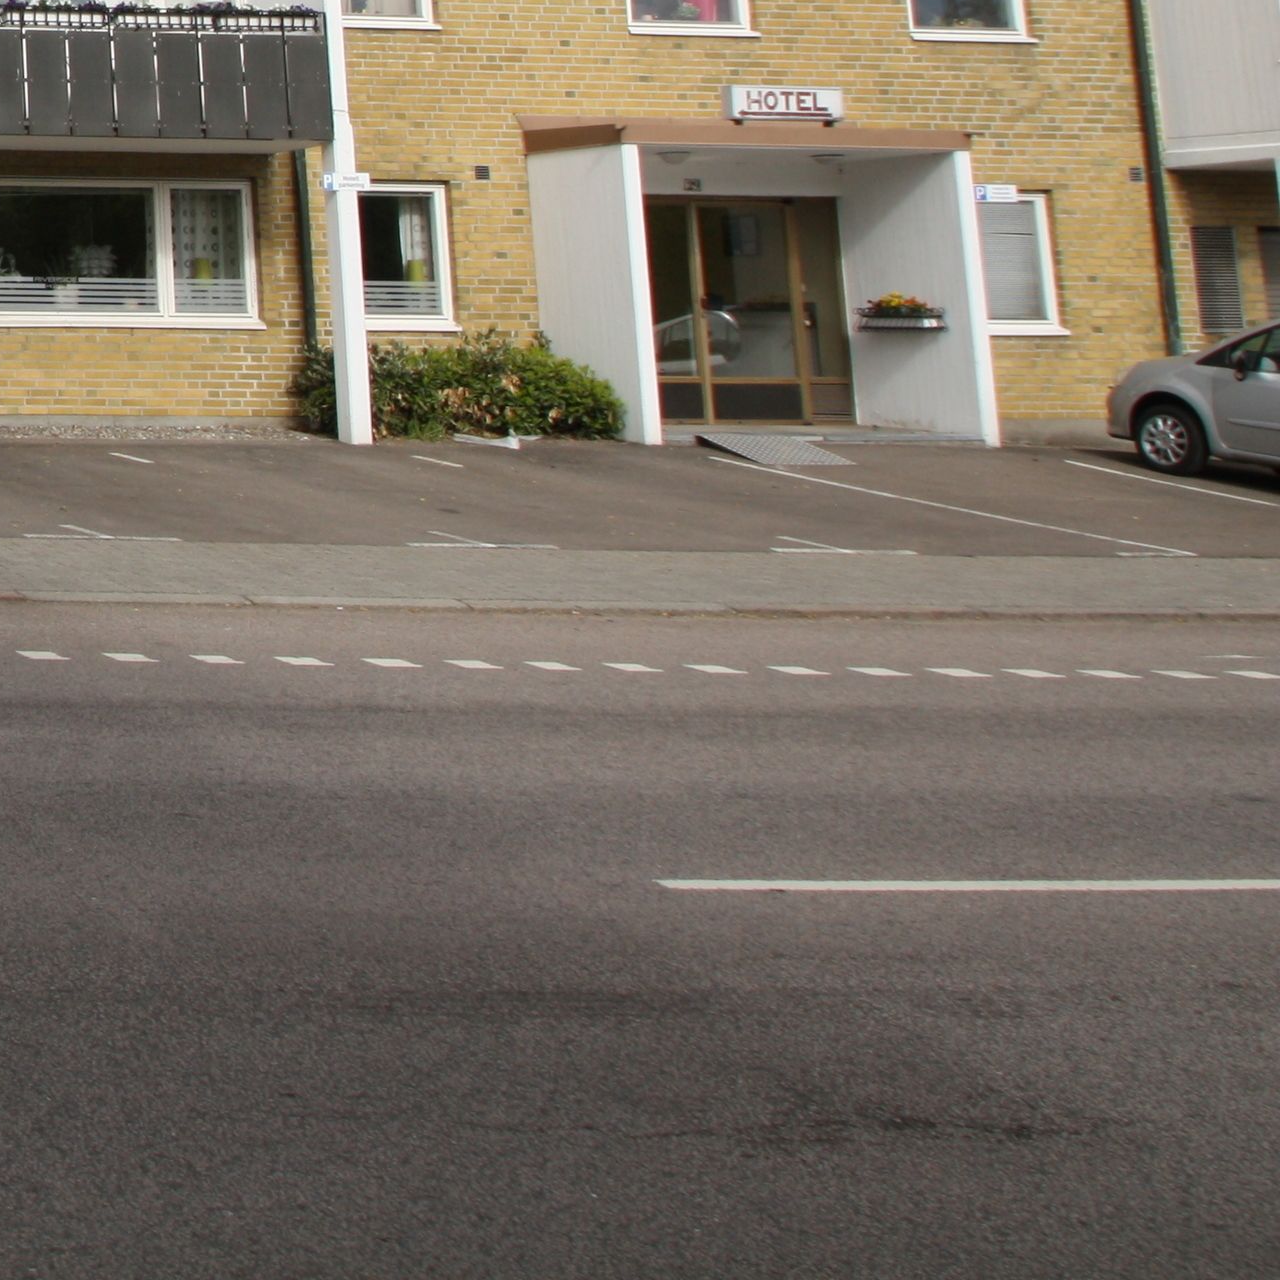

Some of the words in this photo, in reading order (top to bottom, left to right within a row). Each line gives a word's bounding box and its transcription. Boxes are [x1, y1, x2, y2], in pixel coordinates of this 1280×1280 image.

[745, 89, 829, 112] HOTEL
[324, 174, 333, 189] P
[975, 186, 985, 200] P
